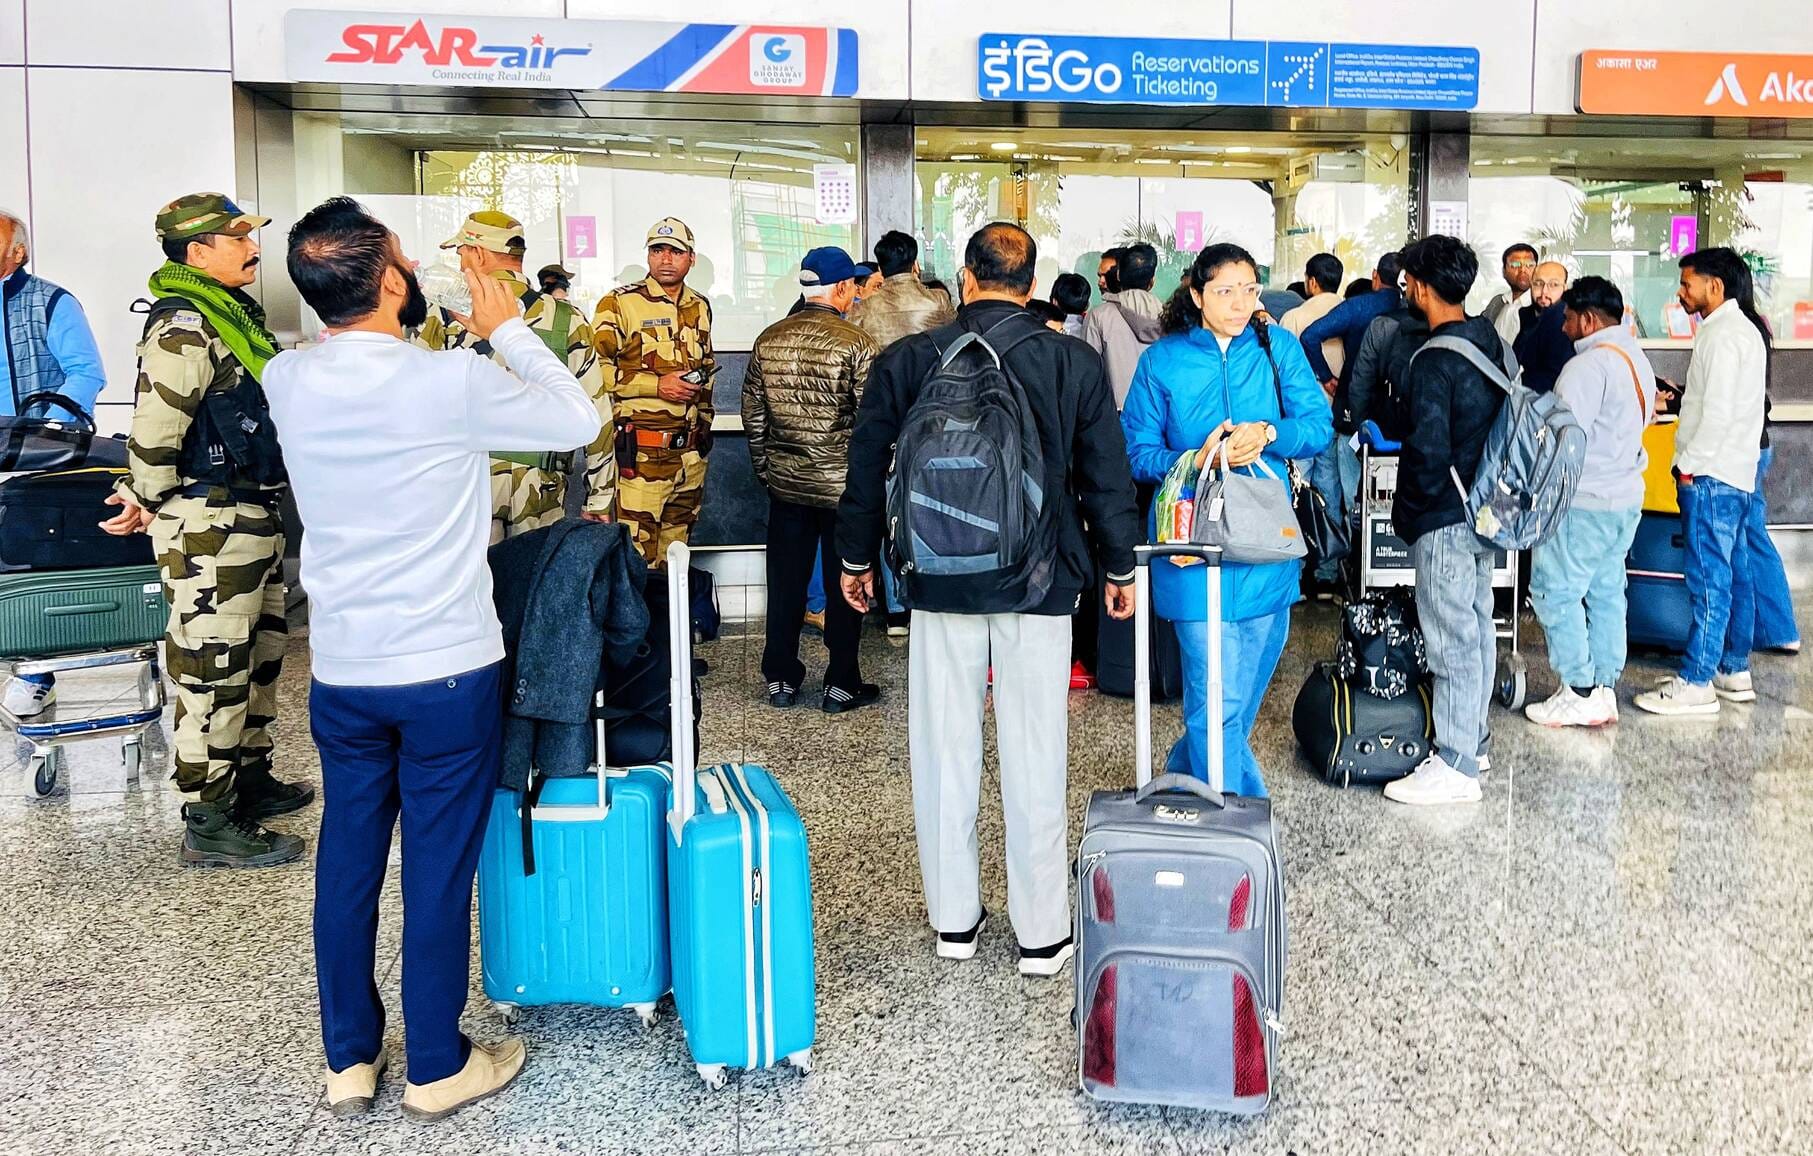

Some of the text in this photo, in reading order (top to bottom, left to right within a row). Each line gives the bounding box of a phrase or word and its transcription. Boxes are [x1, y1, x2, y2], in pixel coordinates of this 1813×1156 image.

[325, 17, 592, 69] STAR air
[1132, 51, 1260, 74] Reservations
[432, 69, 552, 82] Connecting Real India
[1132, 74, 1218, 101] Ticketing
